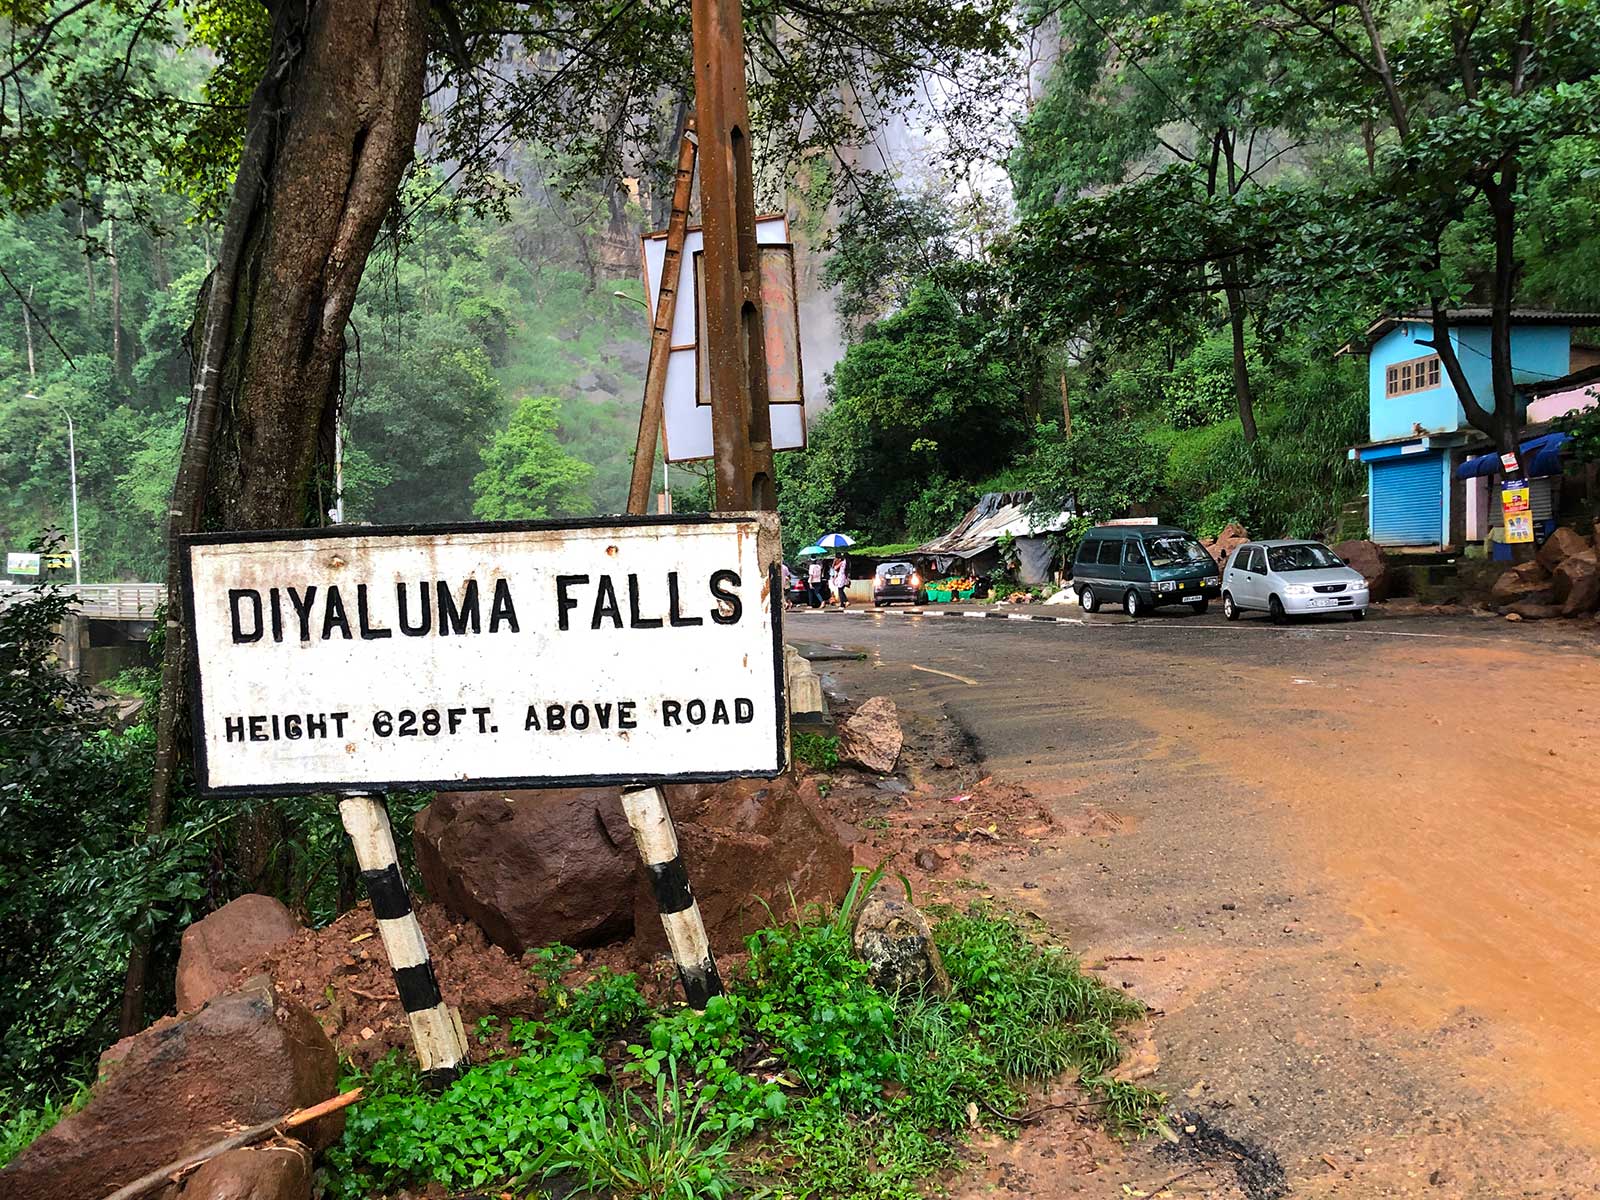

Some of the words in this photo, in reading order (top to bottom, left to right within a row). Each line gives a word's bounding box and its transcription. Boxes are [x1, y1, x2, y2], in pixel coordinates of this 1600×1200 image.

[228, 578, 520, 645] DIYALUMA
[555, 569, 743, 631] FALLS
[224, 711, 349, 743] HEIGHT
[372, 706, 499, 738] 628FT.
[524, 702, 638, 731] ABOVE
[662, 697, 754, 727] ROAD
